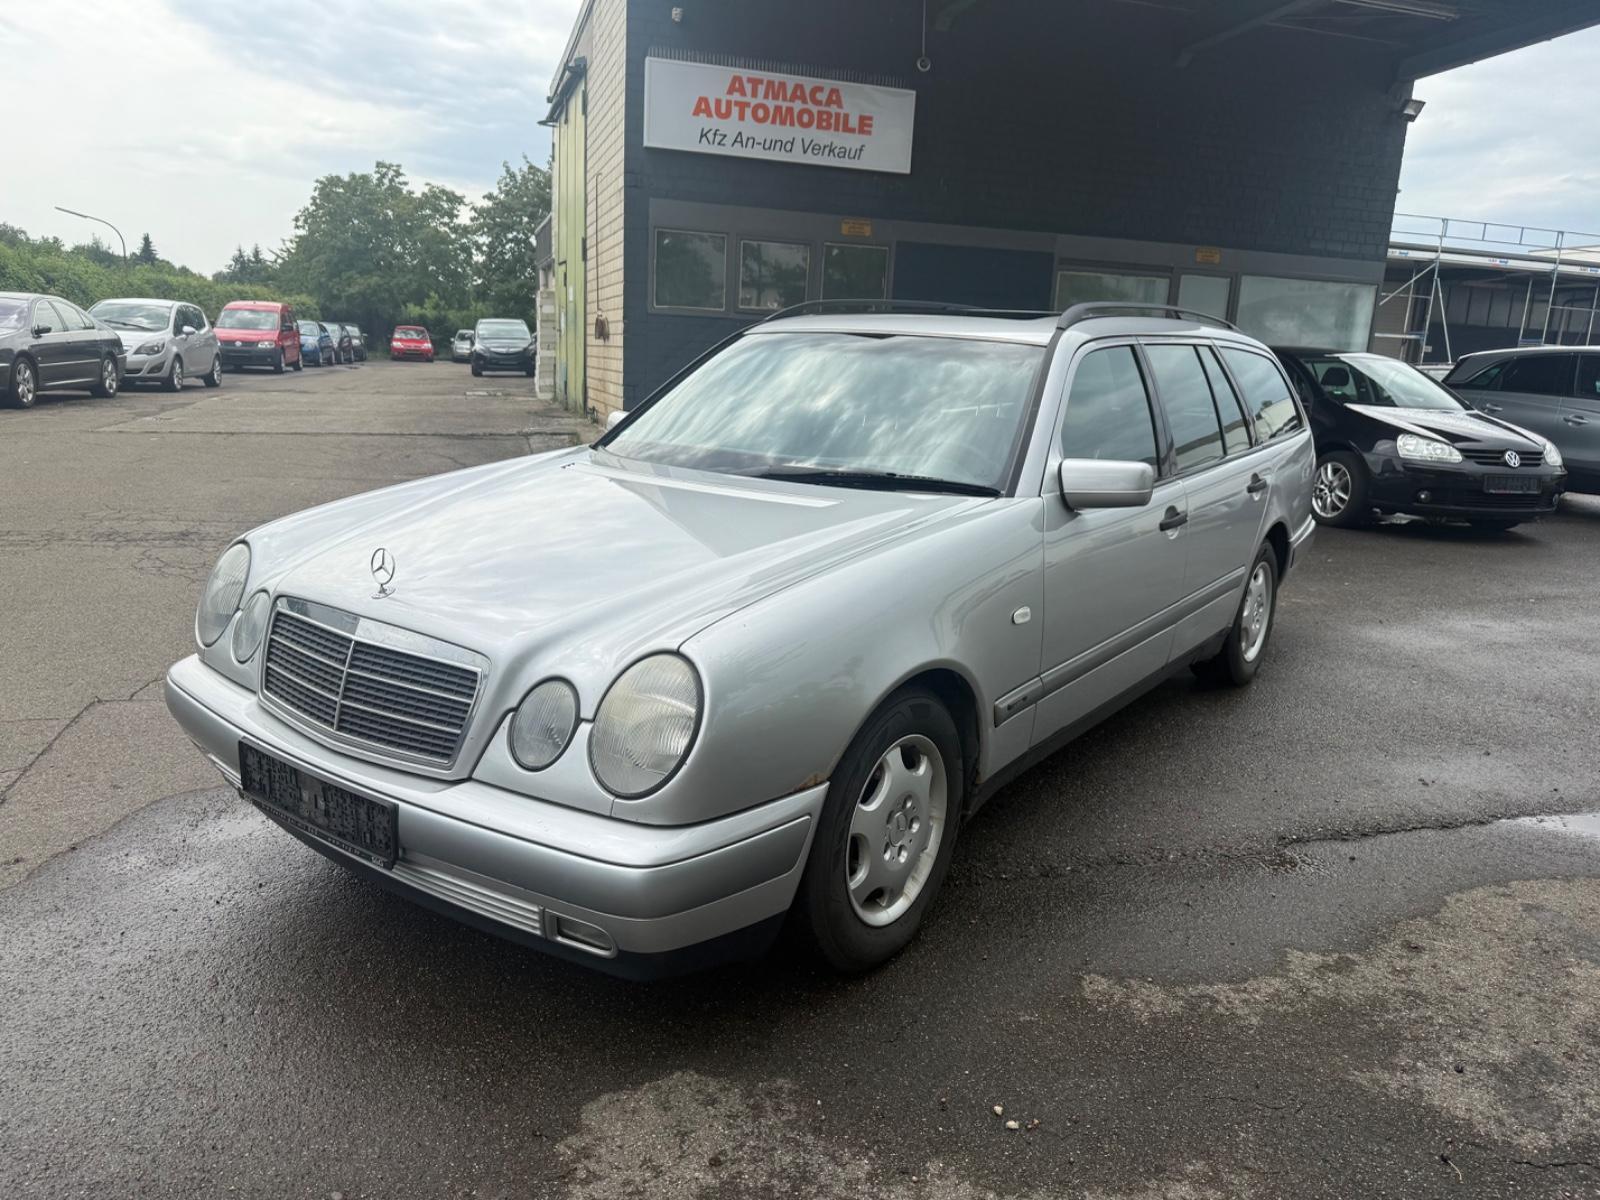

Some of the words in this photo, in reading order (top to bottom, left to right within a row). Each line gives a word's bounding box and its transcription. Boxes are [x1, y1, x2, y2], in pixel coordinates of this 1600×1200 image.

[727, 75, 842, 109] ATMACA
[693, 97, 874, 136] AUTOMOBILE
[699, 127, 727, 147] Kfz
[732, 131, 794, 154] An-und
[801, 138, 865, 160] Verkauf
